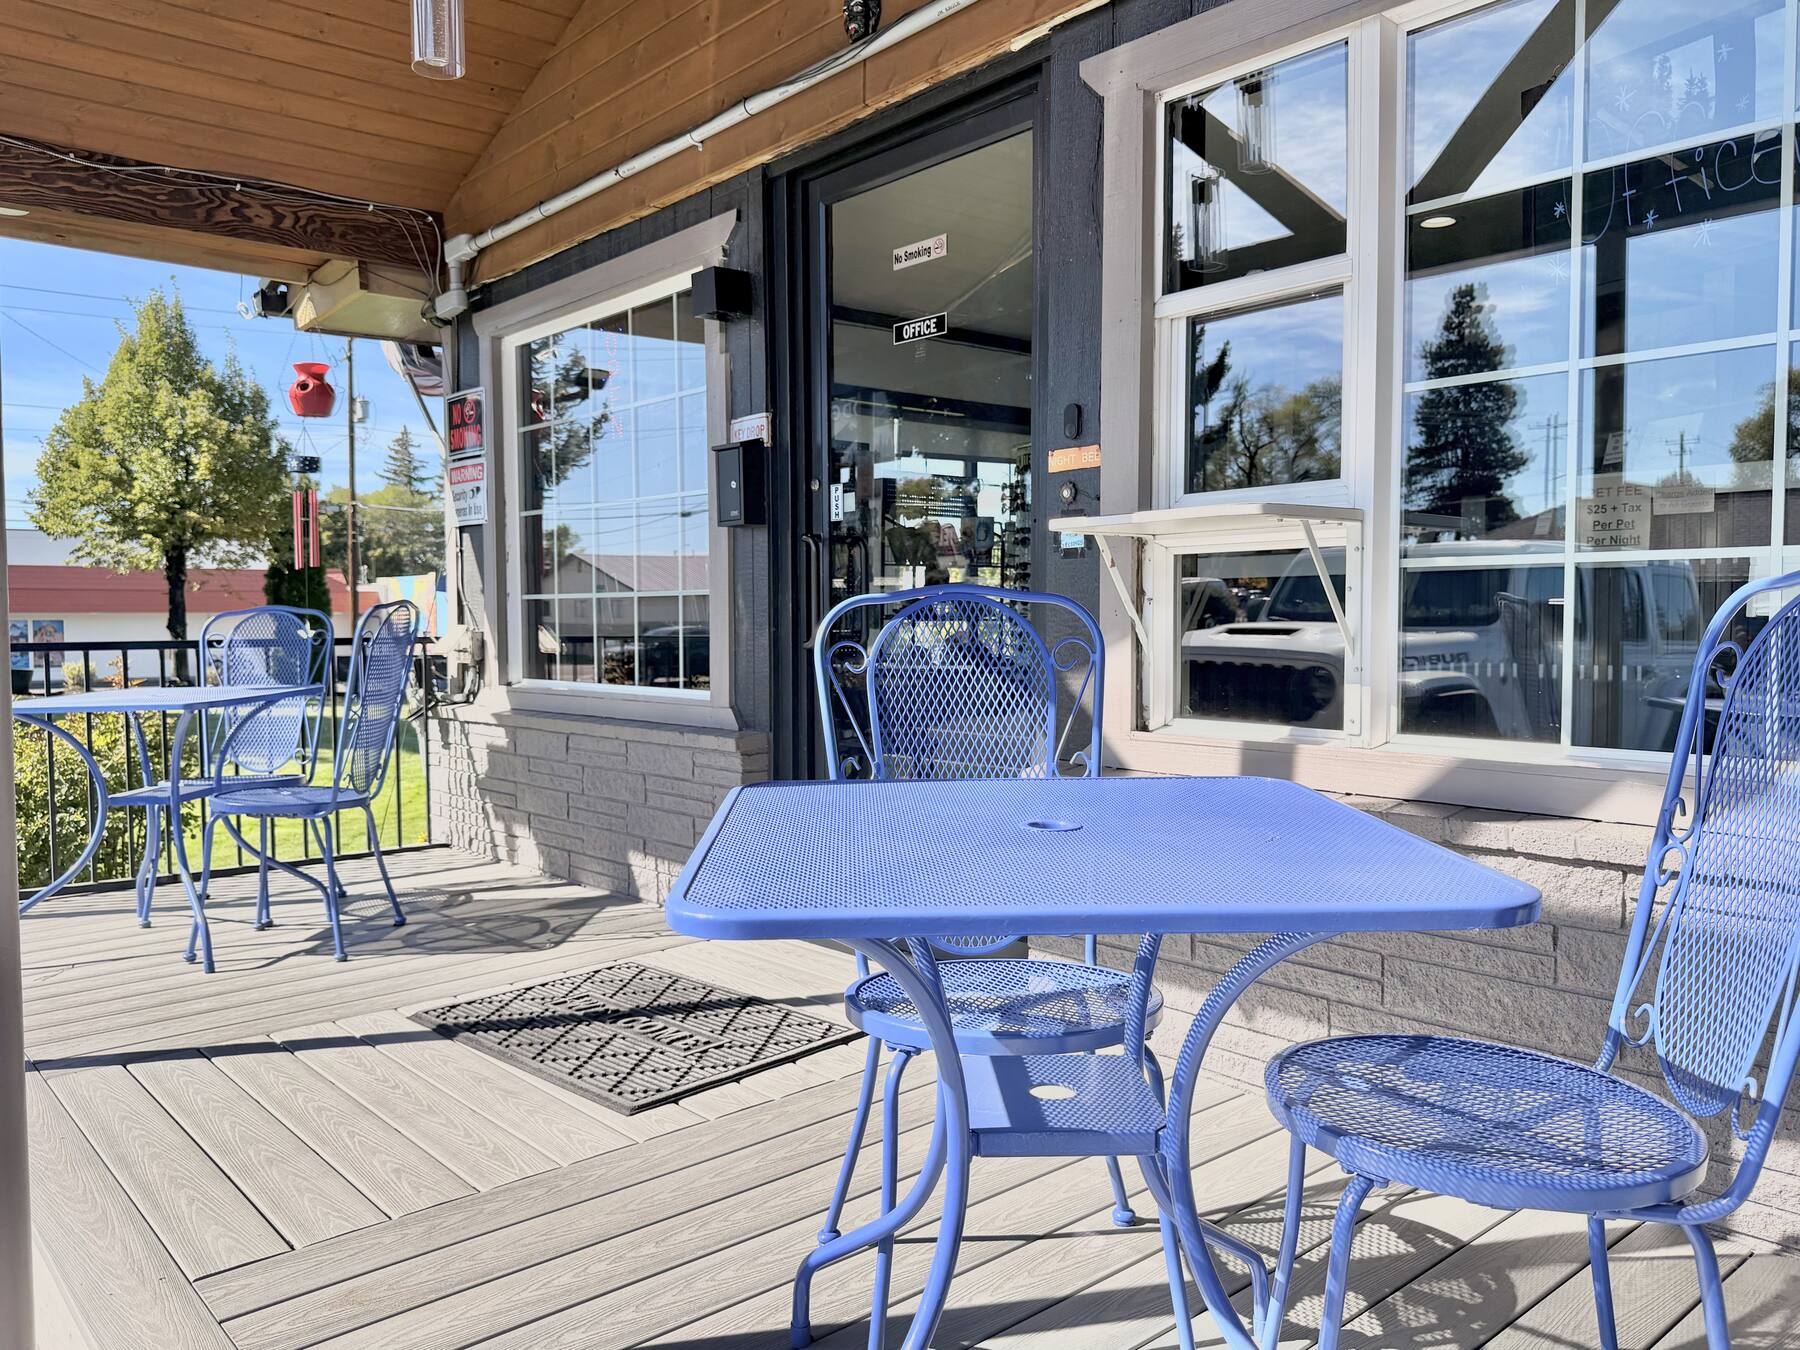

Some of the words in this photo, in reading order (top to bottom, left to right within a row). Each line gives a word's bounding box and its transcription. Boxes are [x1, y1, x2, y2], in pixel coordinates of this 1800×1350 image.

[894, 253, 903, 265] No
[904, 245, 932, 262] Smoking
[902, 318, 938, 339] OFFICE
[452, 403, 462, 425] NO
[450, 424, 482, 450] SMOKING
[734, 428, 746, 440] KEY
[746, 424, 765, 437] DROP
[451, 465, 483, 483] WARNING
[1616, 486, 1643, 497] FEE
[1586, 504, 1608, 516] $25
[1621, 502, 1643, 513] Tax
[1593, 520, 1613, 530] Per
[1616, 518, 1636, 530] Pet
[1586, 535, 1607, 545] Per
[1609, 533, 1642, 546] Night
